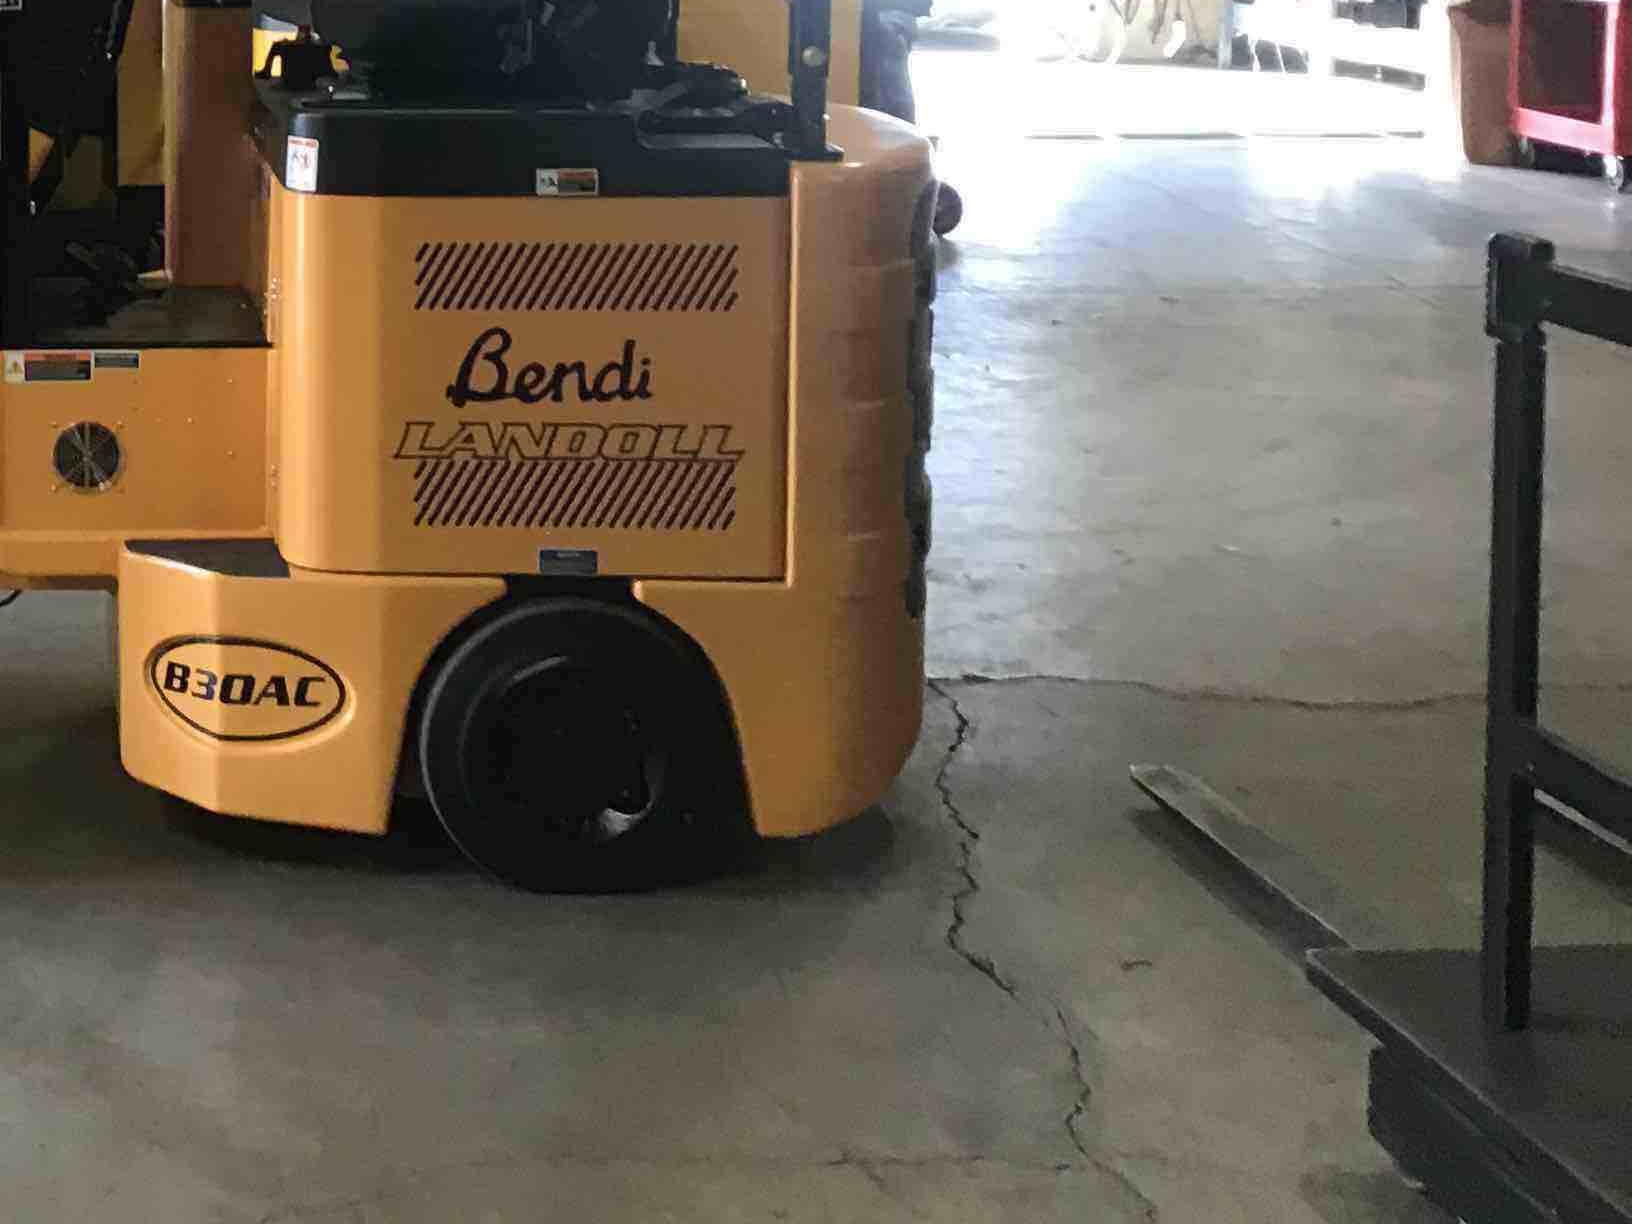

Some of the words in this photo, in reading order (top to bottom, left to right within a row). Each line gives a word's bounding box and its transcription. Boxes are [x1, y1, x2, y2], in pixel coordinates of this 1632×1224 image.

[446, 326, 654, 408] Bendi
[393, 421, 746, 462] LANDOLL
[164, 660, 325, 707] B30AC
